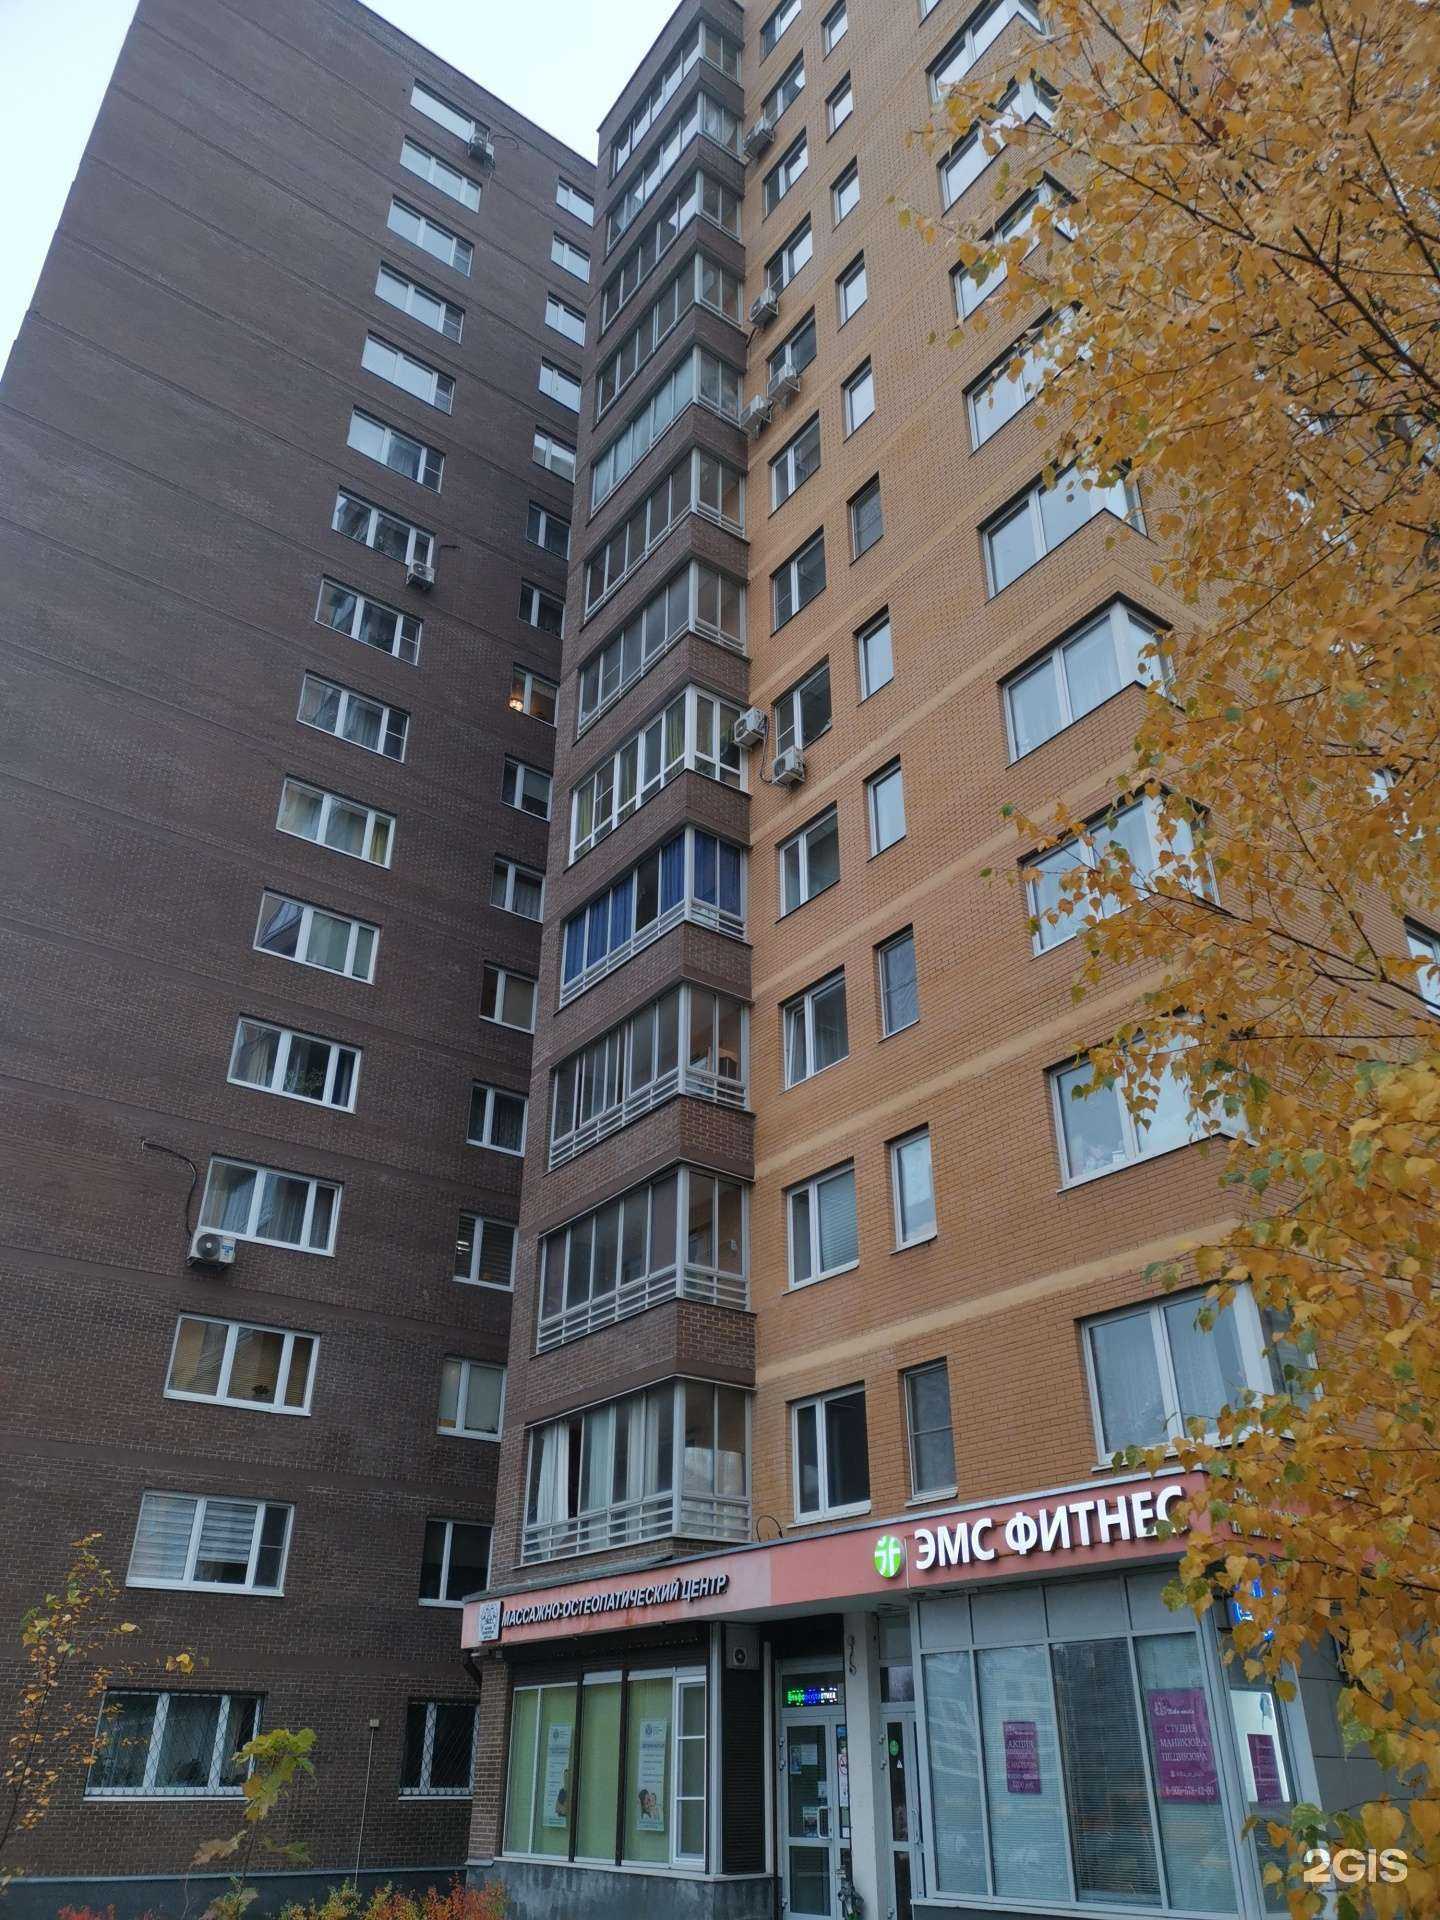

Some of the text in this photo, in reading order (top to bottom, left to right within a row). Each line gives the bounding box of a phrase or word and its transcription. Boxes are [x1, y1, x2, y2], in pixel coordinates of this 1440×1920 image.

[914, 1485, 1188, 1570] ЭМС ФИТНЕС
[501, 1575, 728, 1627] МАССАЖНО-ОСТЕОПАТИЧЕСКИЙ ЦЕНТР
